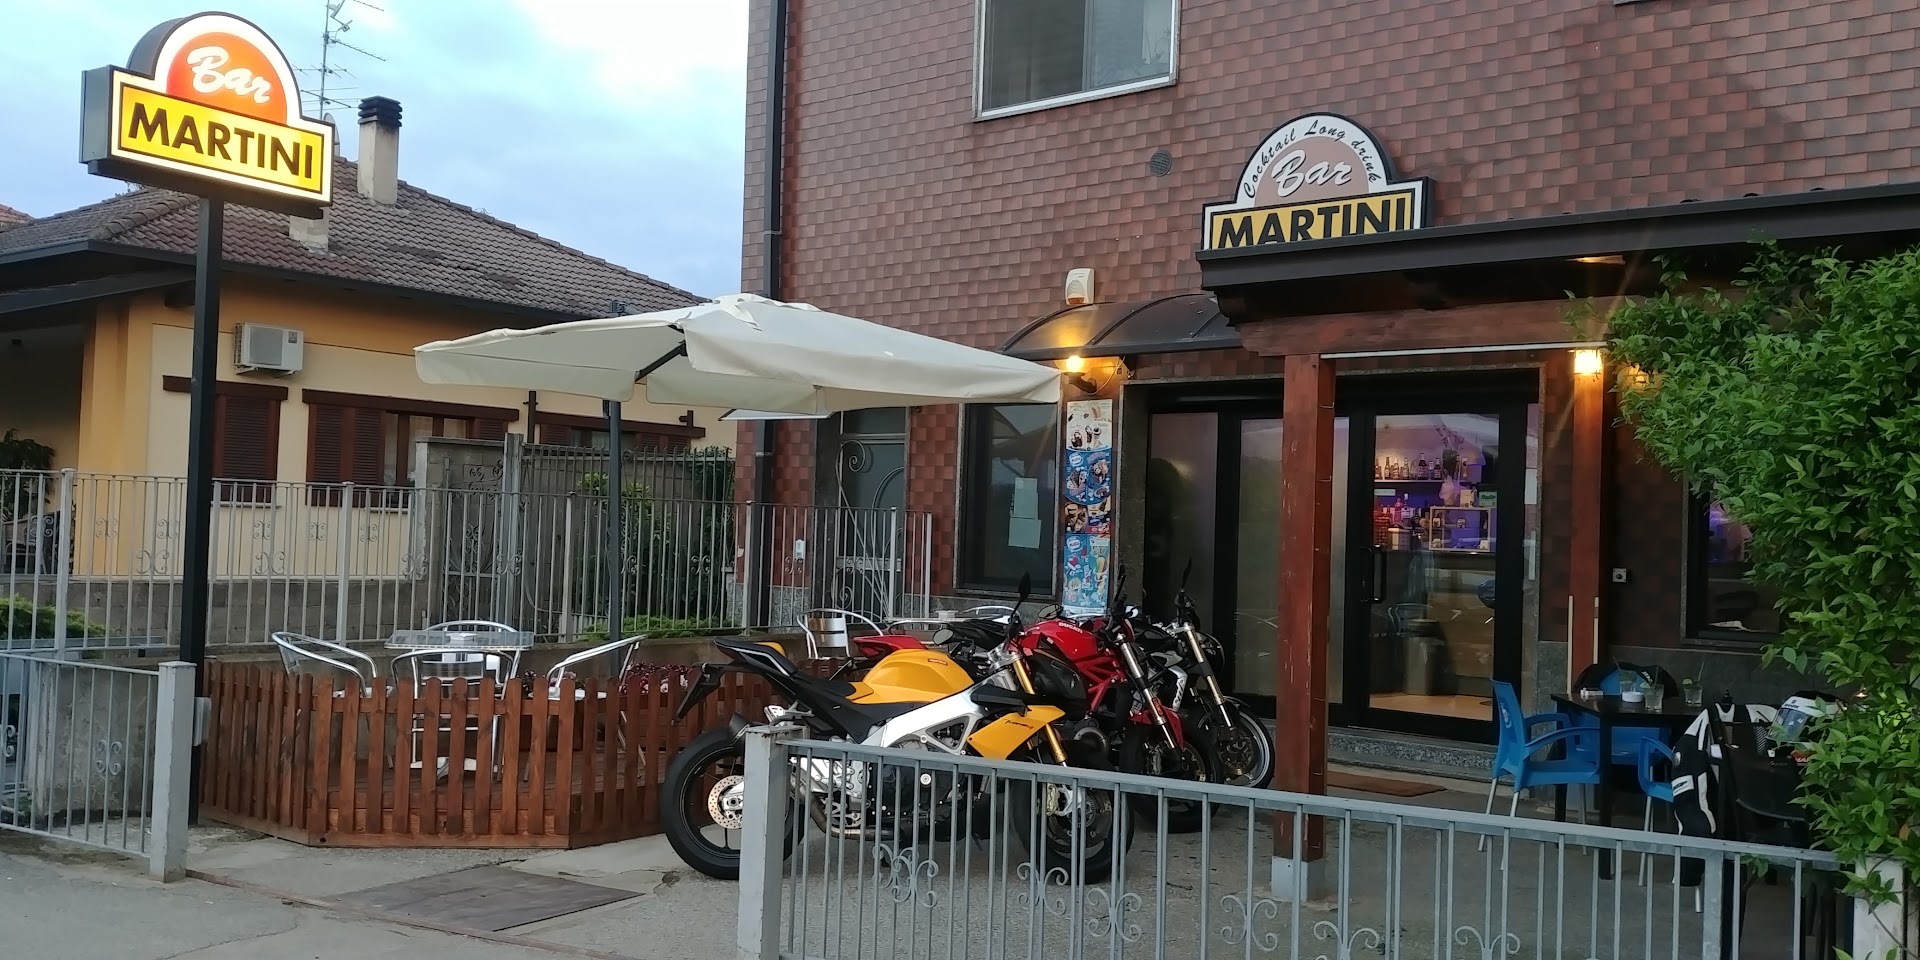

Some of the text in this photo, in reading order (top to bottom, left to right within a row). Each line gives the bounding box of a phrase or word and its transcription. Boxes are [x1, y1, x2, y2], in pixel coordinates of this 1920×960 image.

[187, 45, 271, 103] Bar
[128, 102, 313, 179] MARTINI
[1243, 119, 1383, 199] Cocktail Long drink
[1271, 149, 1352, 197] Bar
[1217, 197, 1406, 249] MARTINI
[1058, 621, 1083, 634] DUCATI
